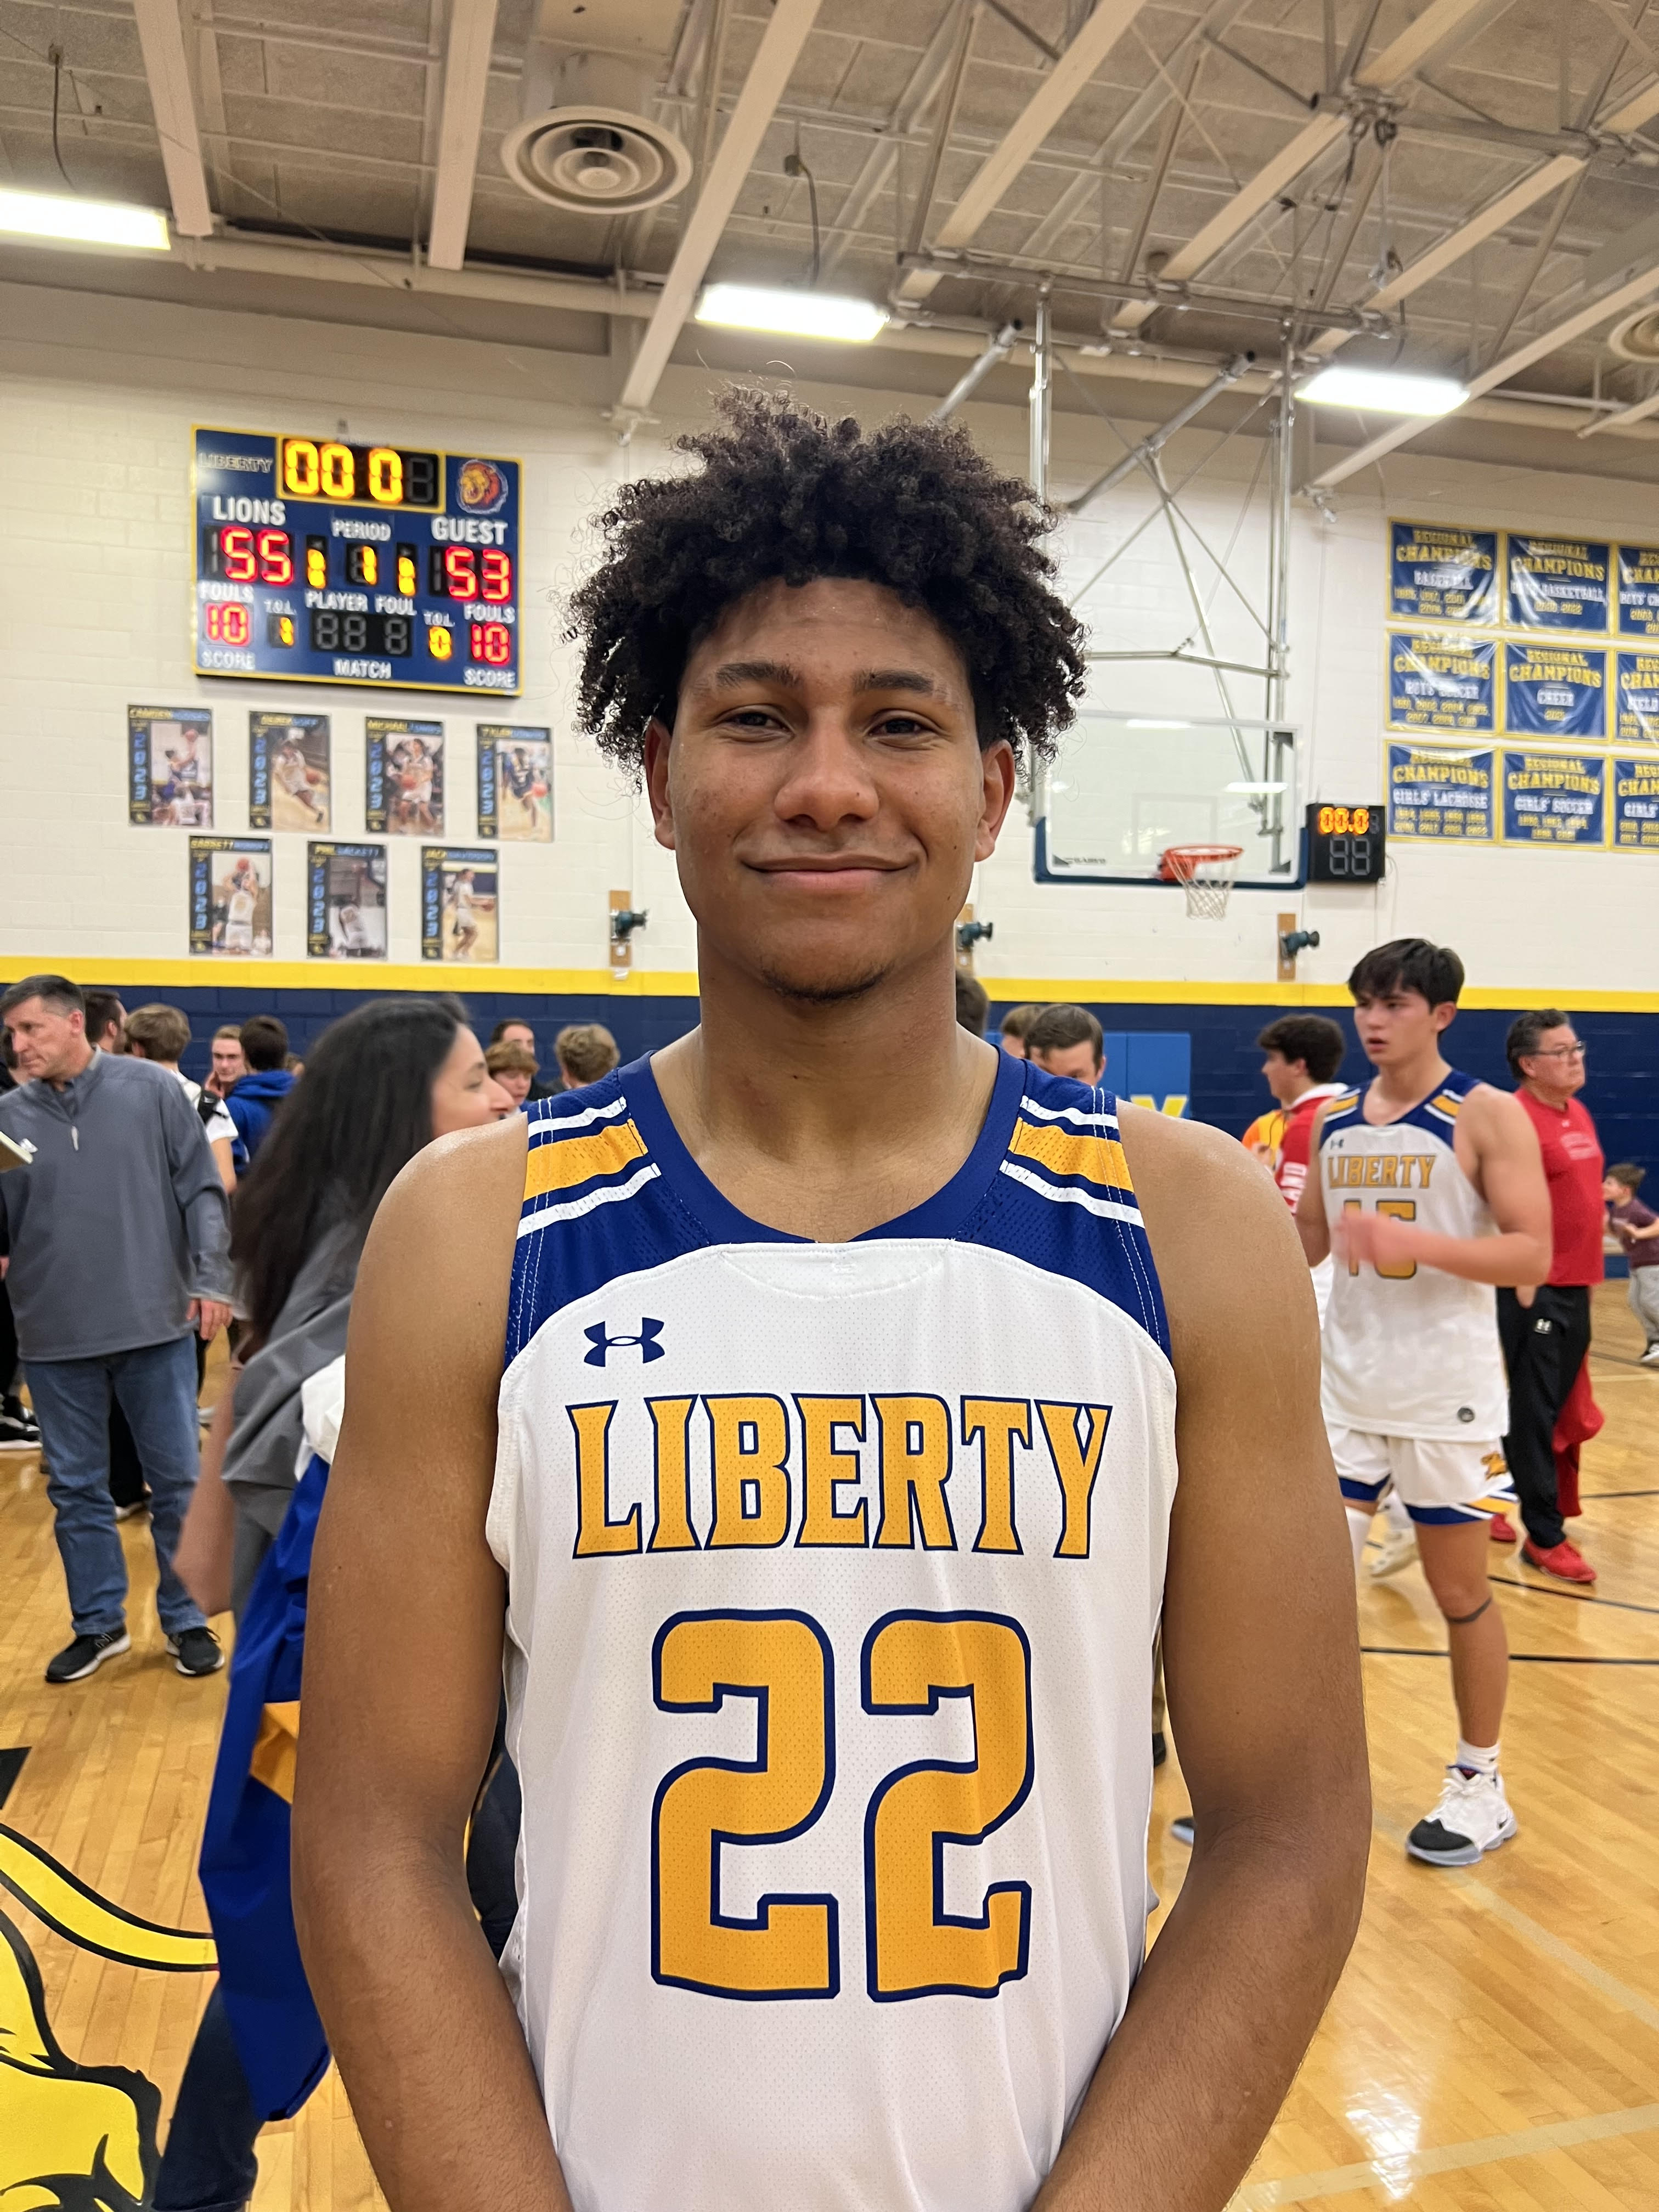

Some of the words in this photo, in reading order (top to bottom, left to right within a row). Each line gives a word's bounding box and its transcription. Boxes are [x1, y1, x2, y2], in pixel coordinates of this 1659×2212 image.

[212, 496, 286, 526] LIONS
[331, 520, 391, 541] PERIOD
[432, 516, 508, 545] GUEST
[221, 525, 294, 587] 55
[1511, 556, 1604, 582] CHAMPIONS
[445, 546, 512, 603] 53
[198, 580, 254, 602] FOULS
[305, 589, 368, 612] PLAYER
[375, 594, 417, 616] FOUL
[205, 601, 250, 647] 10
[464, 603, 516, 624] FOULS
[429, 626, 452, 659] 0
[471, 622, 511, 665] 10
[201, 650, 256, 670] SCORE
[334, 658, 392, 680] MATCH
[464, 668, 516, 689] SCORE
[1509, 663, 1602, 689] CHAMPIONS
[1393, 765, 1489, 788] CHAMPIONS
[1508, 772, 1600, 795] CHAMPIONS
[1433, 789, 1488, 809] LACROSSE
[1328, 1154, 1436, 1189] LIBERTY
[566, 1393, 1113, 1560] LIBERTY
[651, 1609, 1035, 2002] 22
